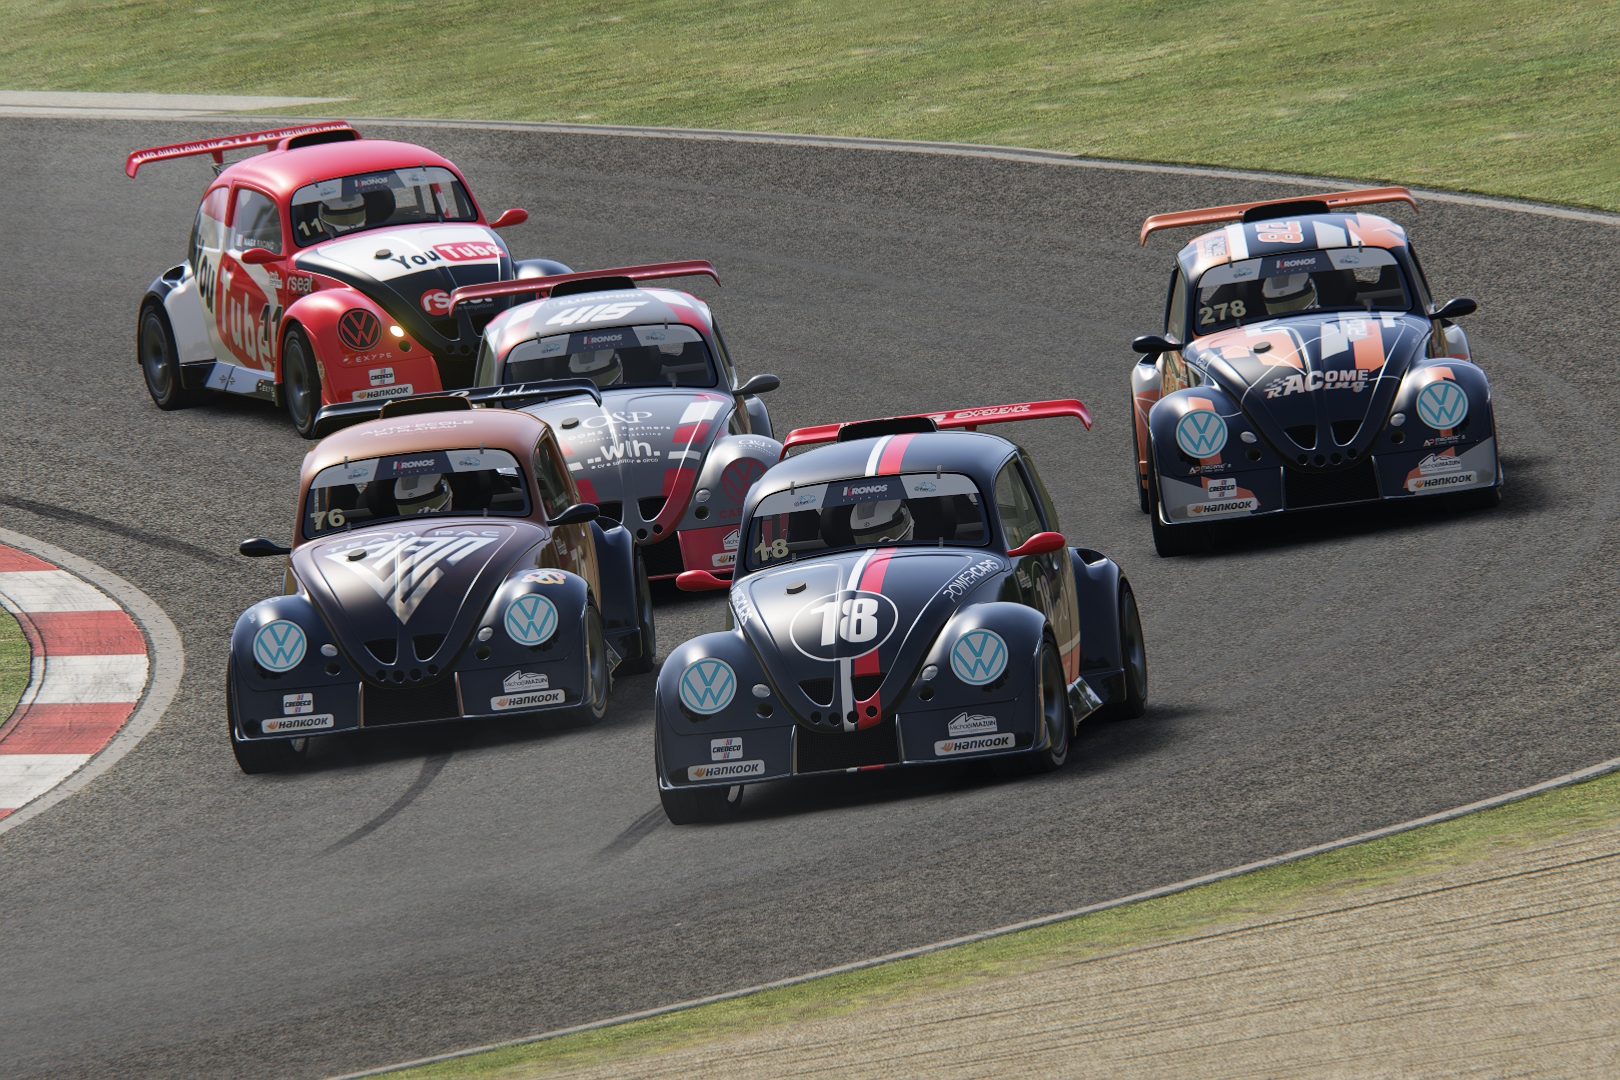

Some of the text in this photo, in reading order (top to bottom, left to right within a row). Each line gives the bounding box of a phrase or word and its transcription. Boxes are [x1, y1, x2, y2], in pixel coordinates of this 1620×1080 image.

[354, 177, 389, 188] KRONOS
[298, 217, 323, 237] 11
[1275, 257, 1317, 269] KRONOS
[287, 274, 313, 292] rseat
[546, 301, 648, 326] 415
[1199, 300, 1247, 325] 278
[583, 333, 623, 345] KRONOS
[366, 387, 409, 399] Hankook
[953, 404, 1031, 419] EXPERIENCE
[393, 459, 435, 471] KRONOS
[1424, 474, 1473, 487] Hankook
[842, 483, 888, 497] KRONOS
[1203, 500, 1253, 513] Hankook
[310, 508, 345, 530] 76
[327, 531, 416, 553] TEAM
[754, 539, 789, 561] 18
[942, 559, 999, 602] POWERCARS
[810, 597, 879, 647] 18
[284, 700, 312, 708] CREDECO
[508, 692, 560, 706] Hankook
[278, 717, 329, 730] Hankook
[712, 744, 741, 753] CREDECO
[953, 736, 1009, 751] Hankook
[705, 763, 759, 777] Hankook
